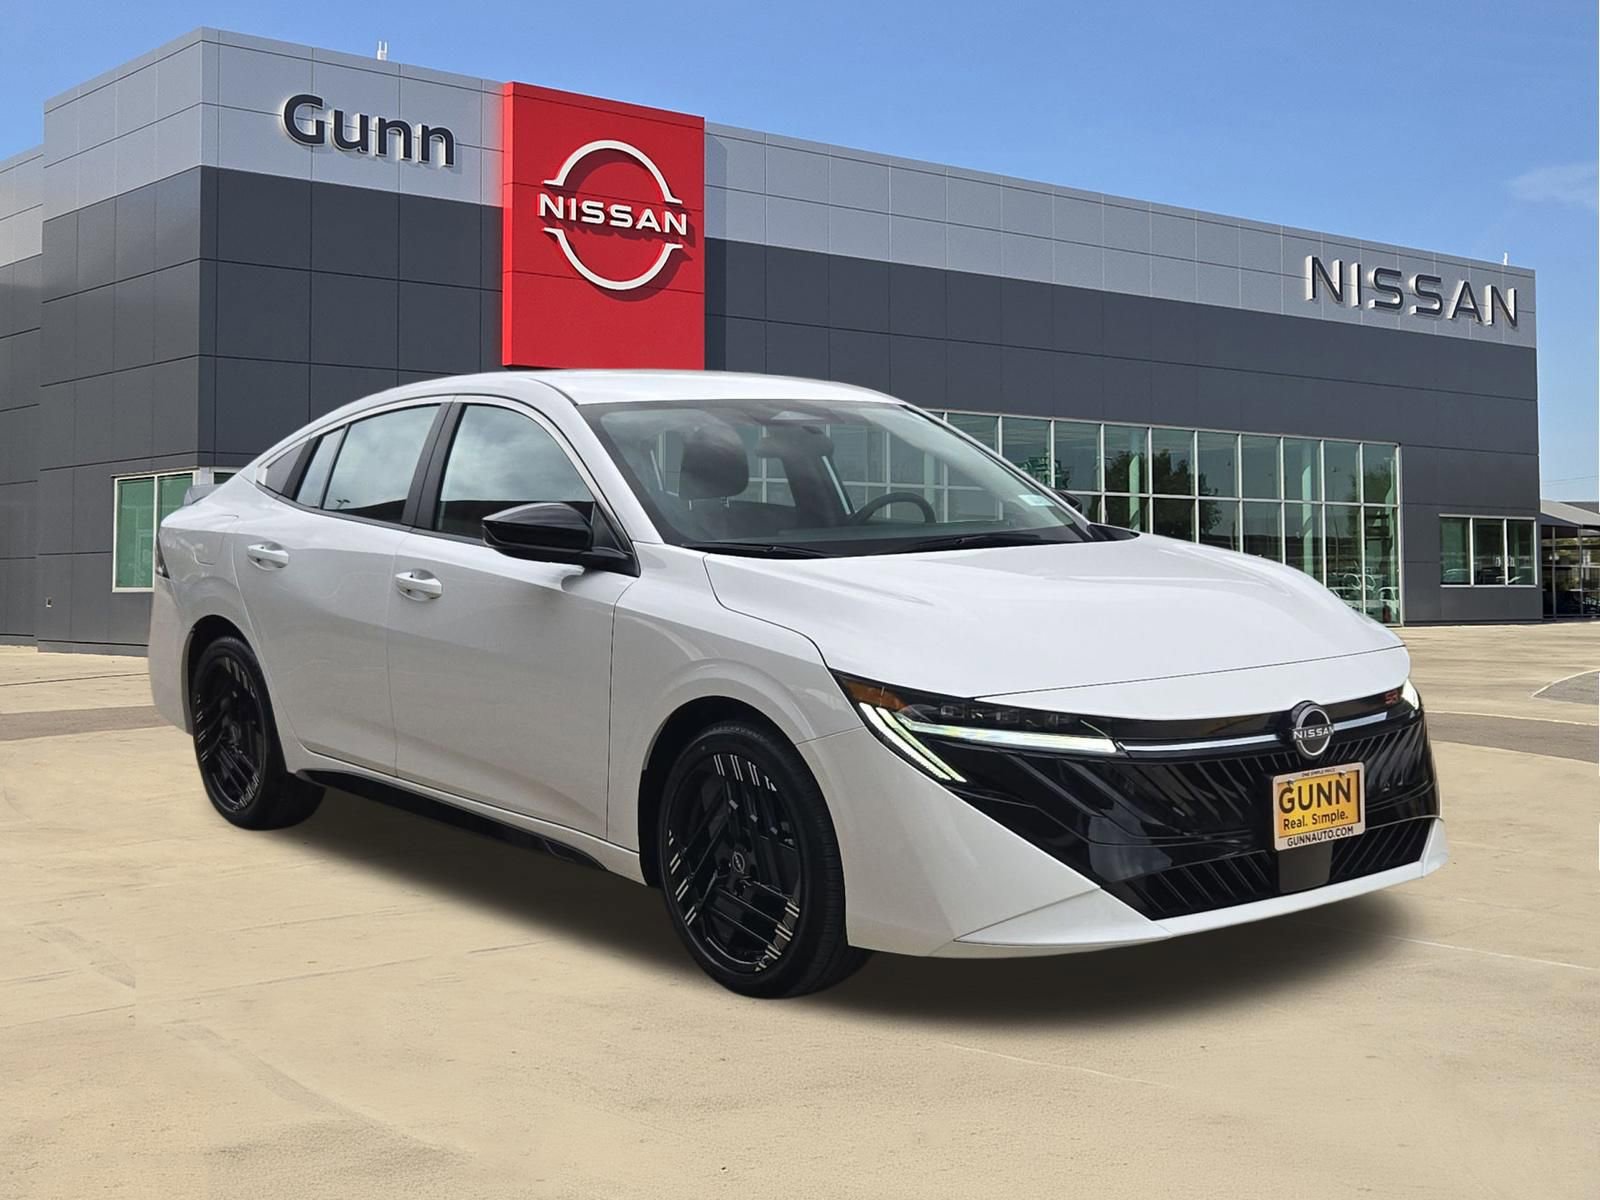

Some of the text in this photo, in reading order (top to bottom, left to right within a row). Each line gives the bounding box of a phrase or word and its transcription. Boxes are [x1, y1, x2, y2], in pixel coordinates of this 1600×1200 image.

[282, 93, 456, 168] Gunn
[538, 193, 688, 236] NISSAN
[1305, 255, 1518, 327] NISSAN
[1293, 725, 1334, 740] NISSAN
[1279, 778, 1351, 814] GUNN
[1283, 817, 1308, 831] Real.
[1287, 826, 1354, 847] GUNNAUTO.COM
